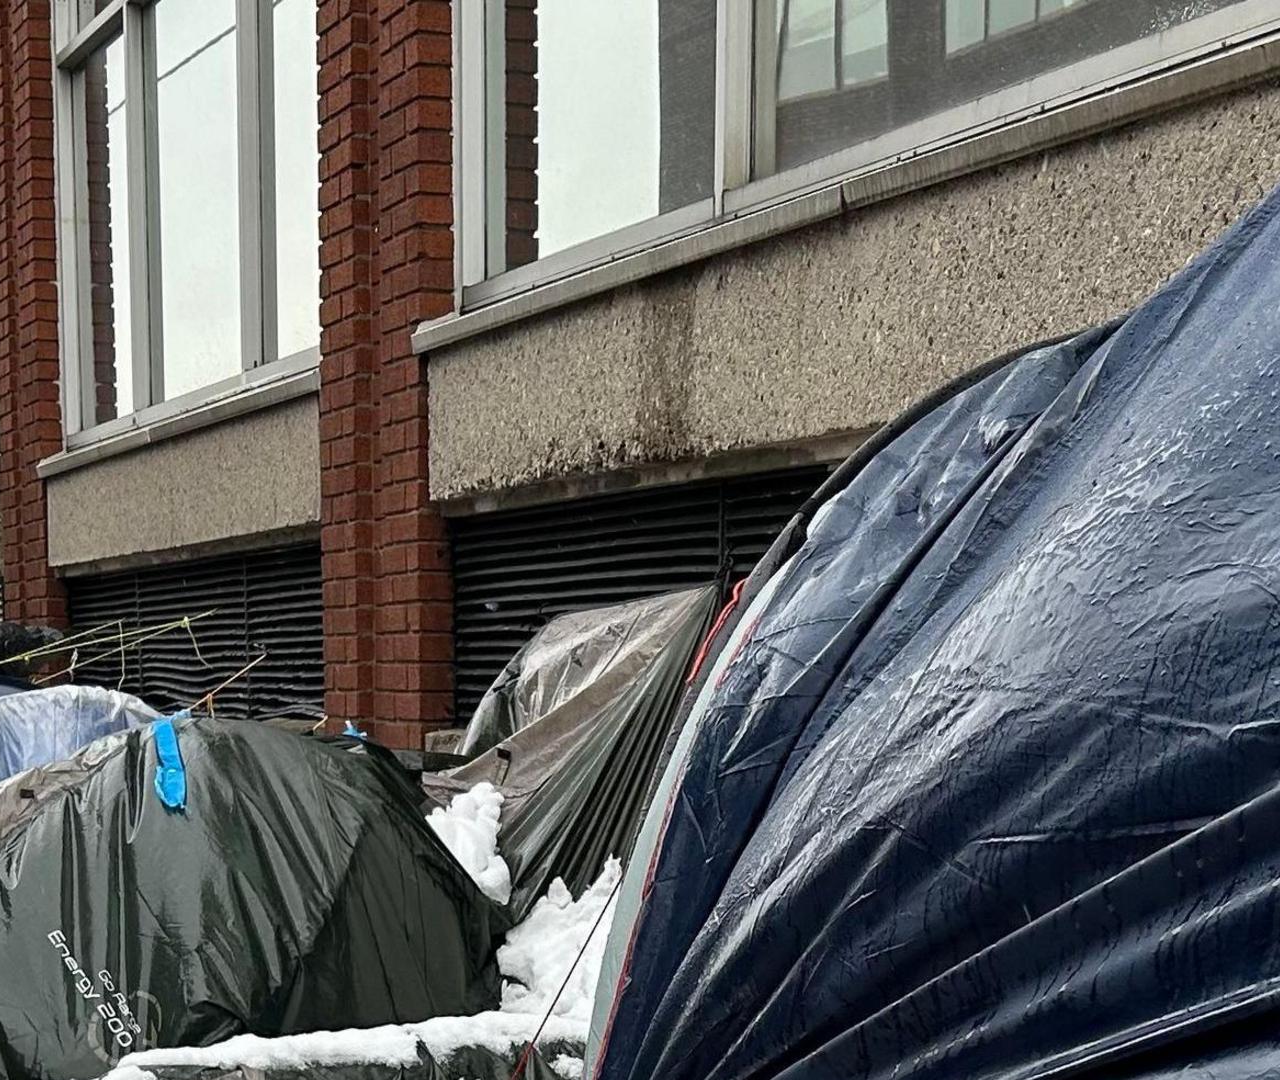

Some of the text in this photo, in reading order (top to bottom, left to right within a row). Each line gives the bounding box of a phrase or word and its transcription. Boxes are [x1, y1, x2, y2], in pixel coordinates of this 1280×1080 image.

[47, 929, 133, 1047] Energy 200
[98, 969, 116, 992] Go
